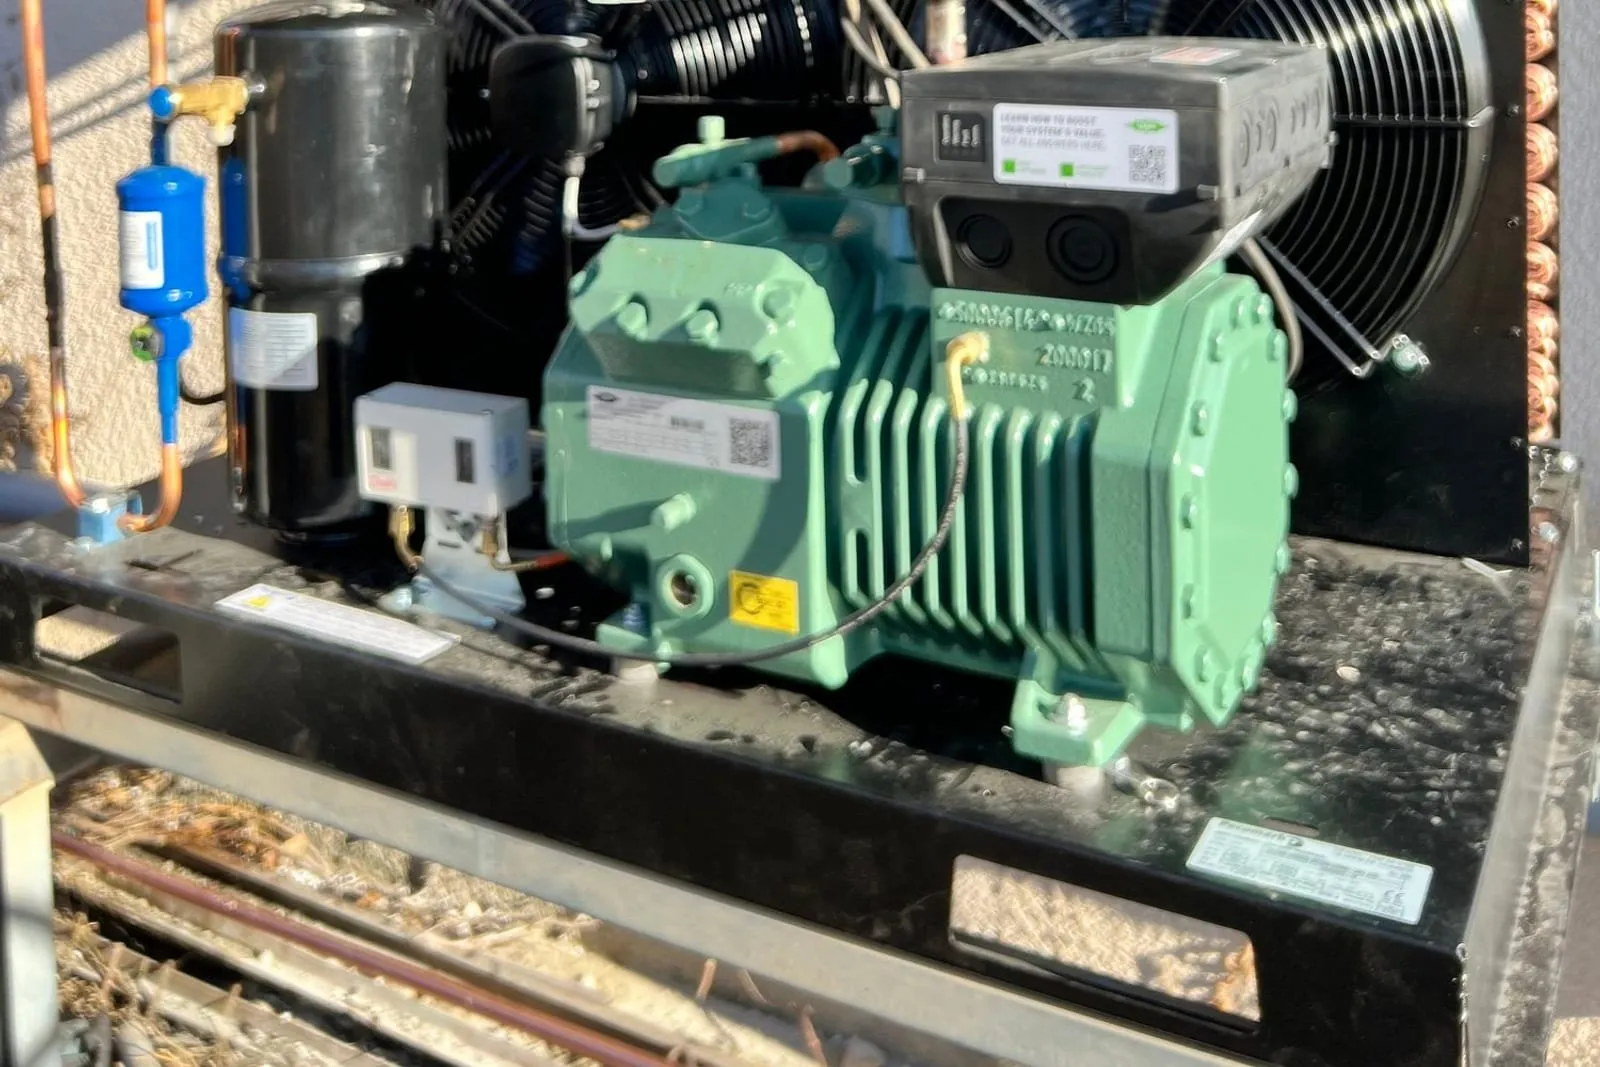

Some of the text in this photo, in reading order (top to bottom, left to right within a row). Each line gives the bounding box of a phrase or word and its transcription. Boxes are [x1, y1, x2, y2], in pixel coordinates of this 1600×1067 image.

[1000, 113, 1096, 126] LEARN HOW TO BOOST
